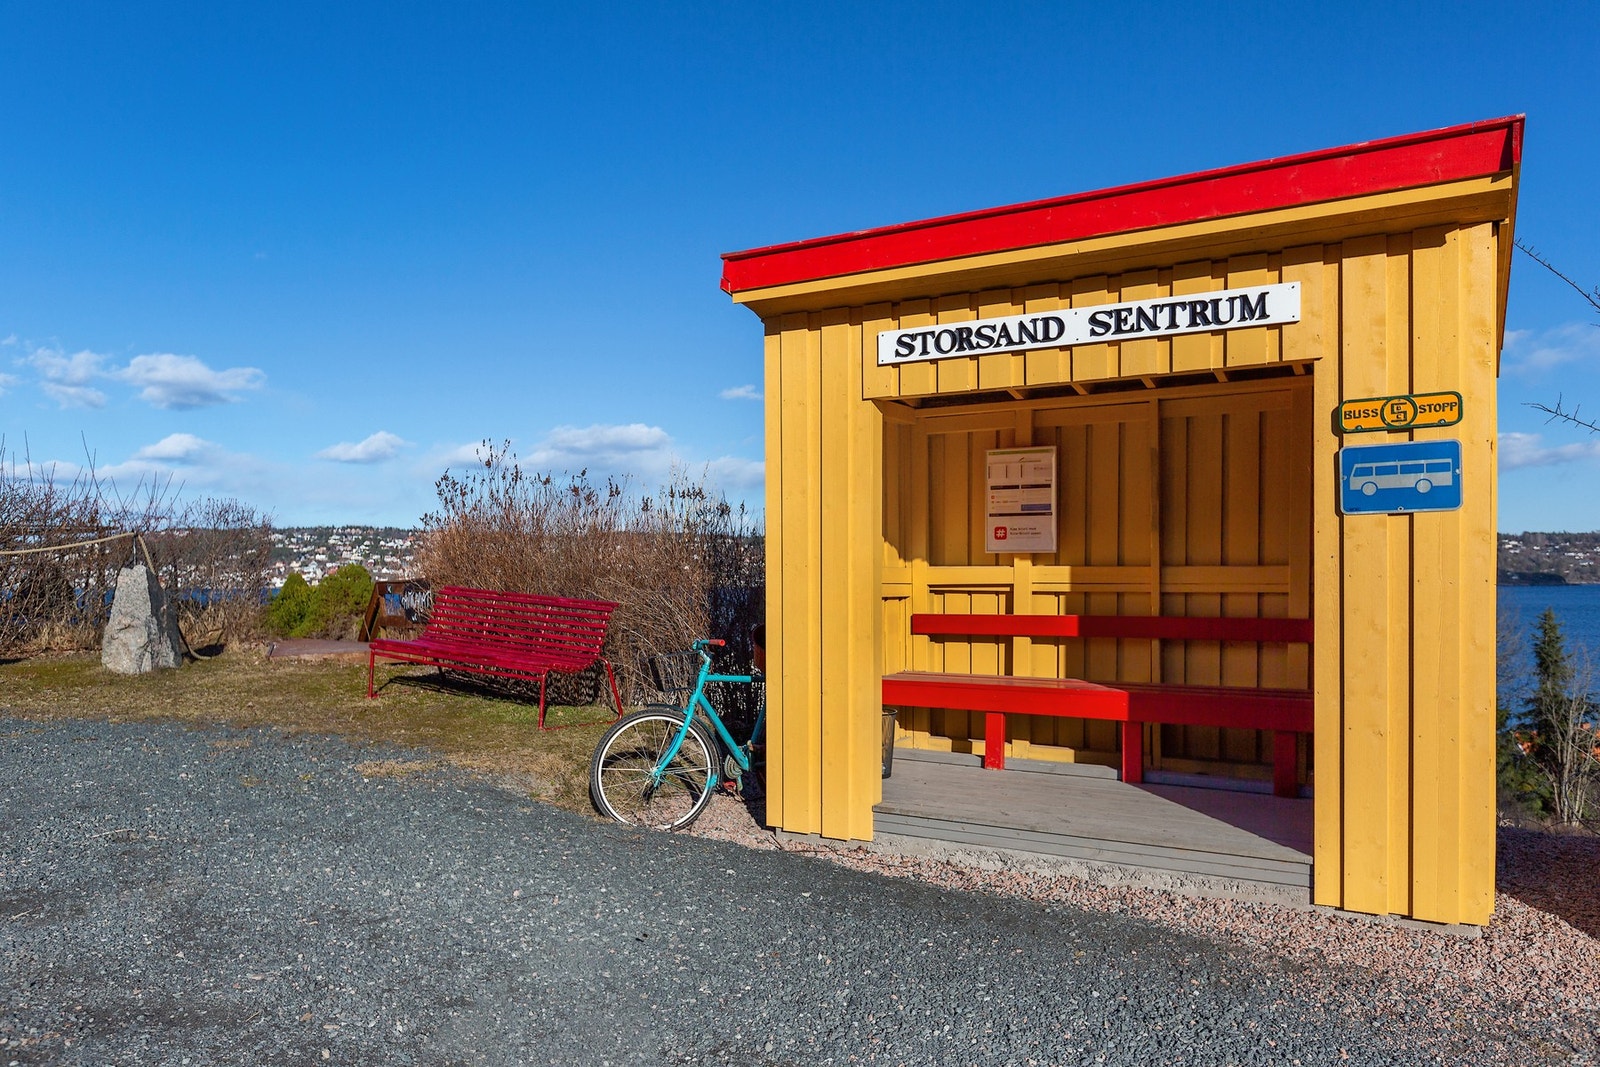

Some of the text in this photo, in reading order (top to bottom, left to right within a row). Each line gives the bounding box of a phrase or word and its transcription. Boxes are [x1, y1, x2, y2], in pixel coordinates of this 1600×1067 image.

[894, 291, 1270, 358] STORSAND SENTRUM
[1343, 408, 1379, 420] BUSS
[1418, 402, 1458, 414] STOPP
